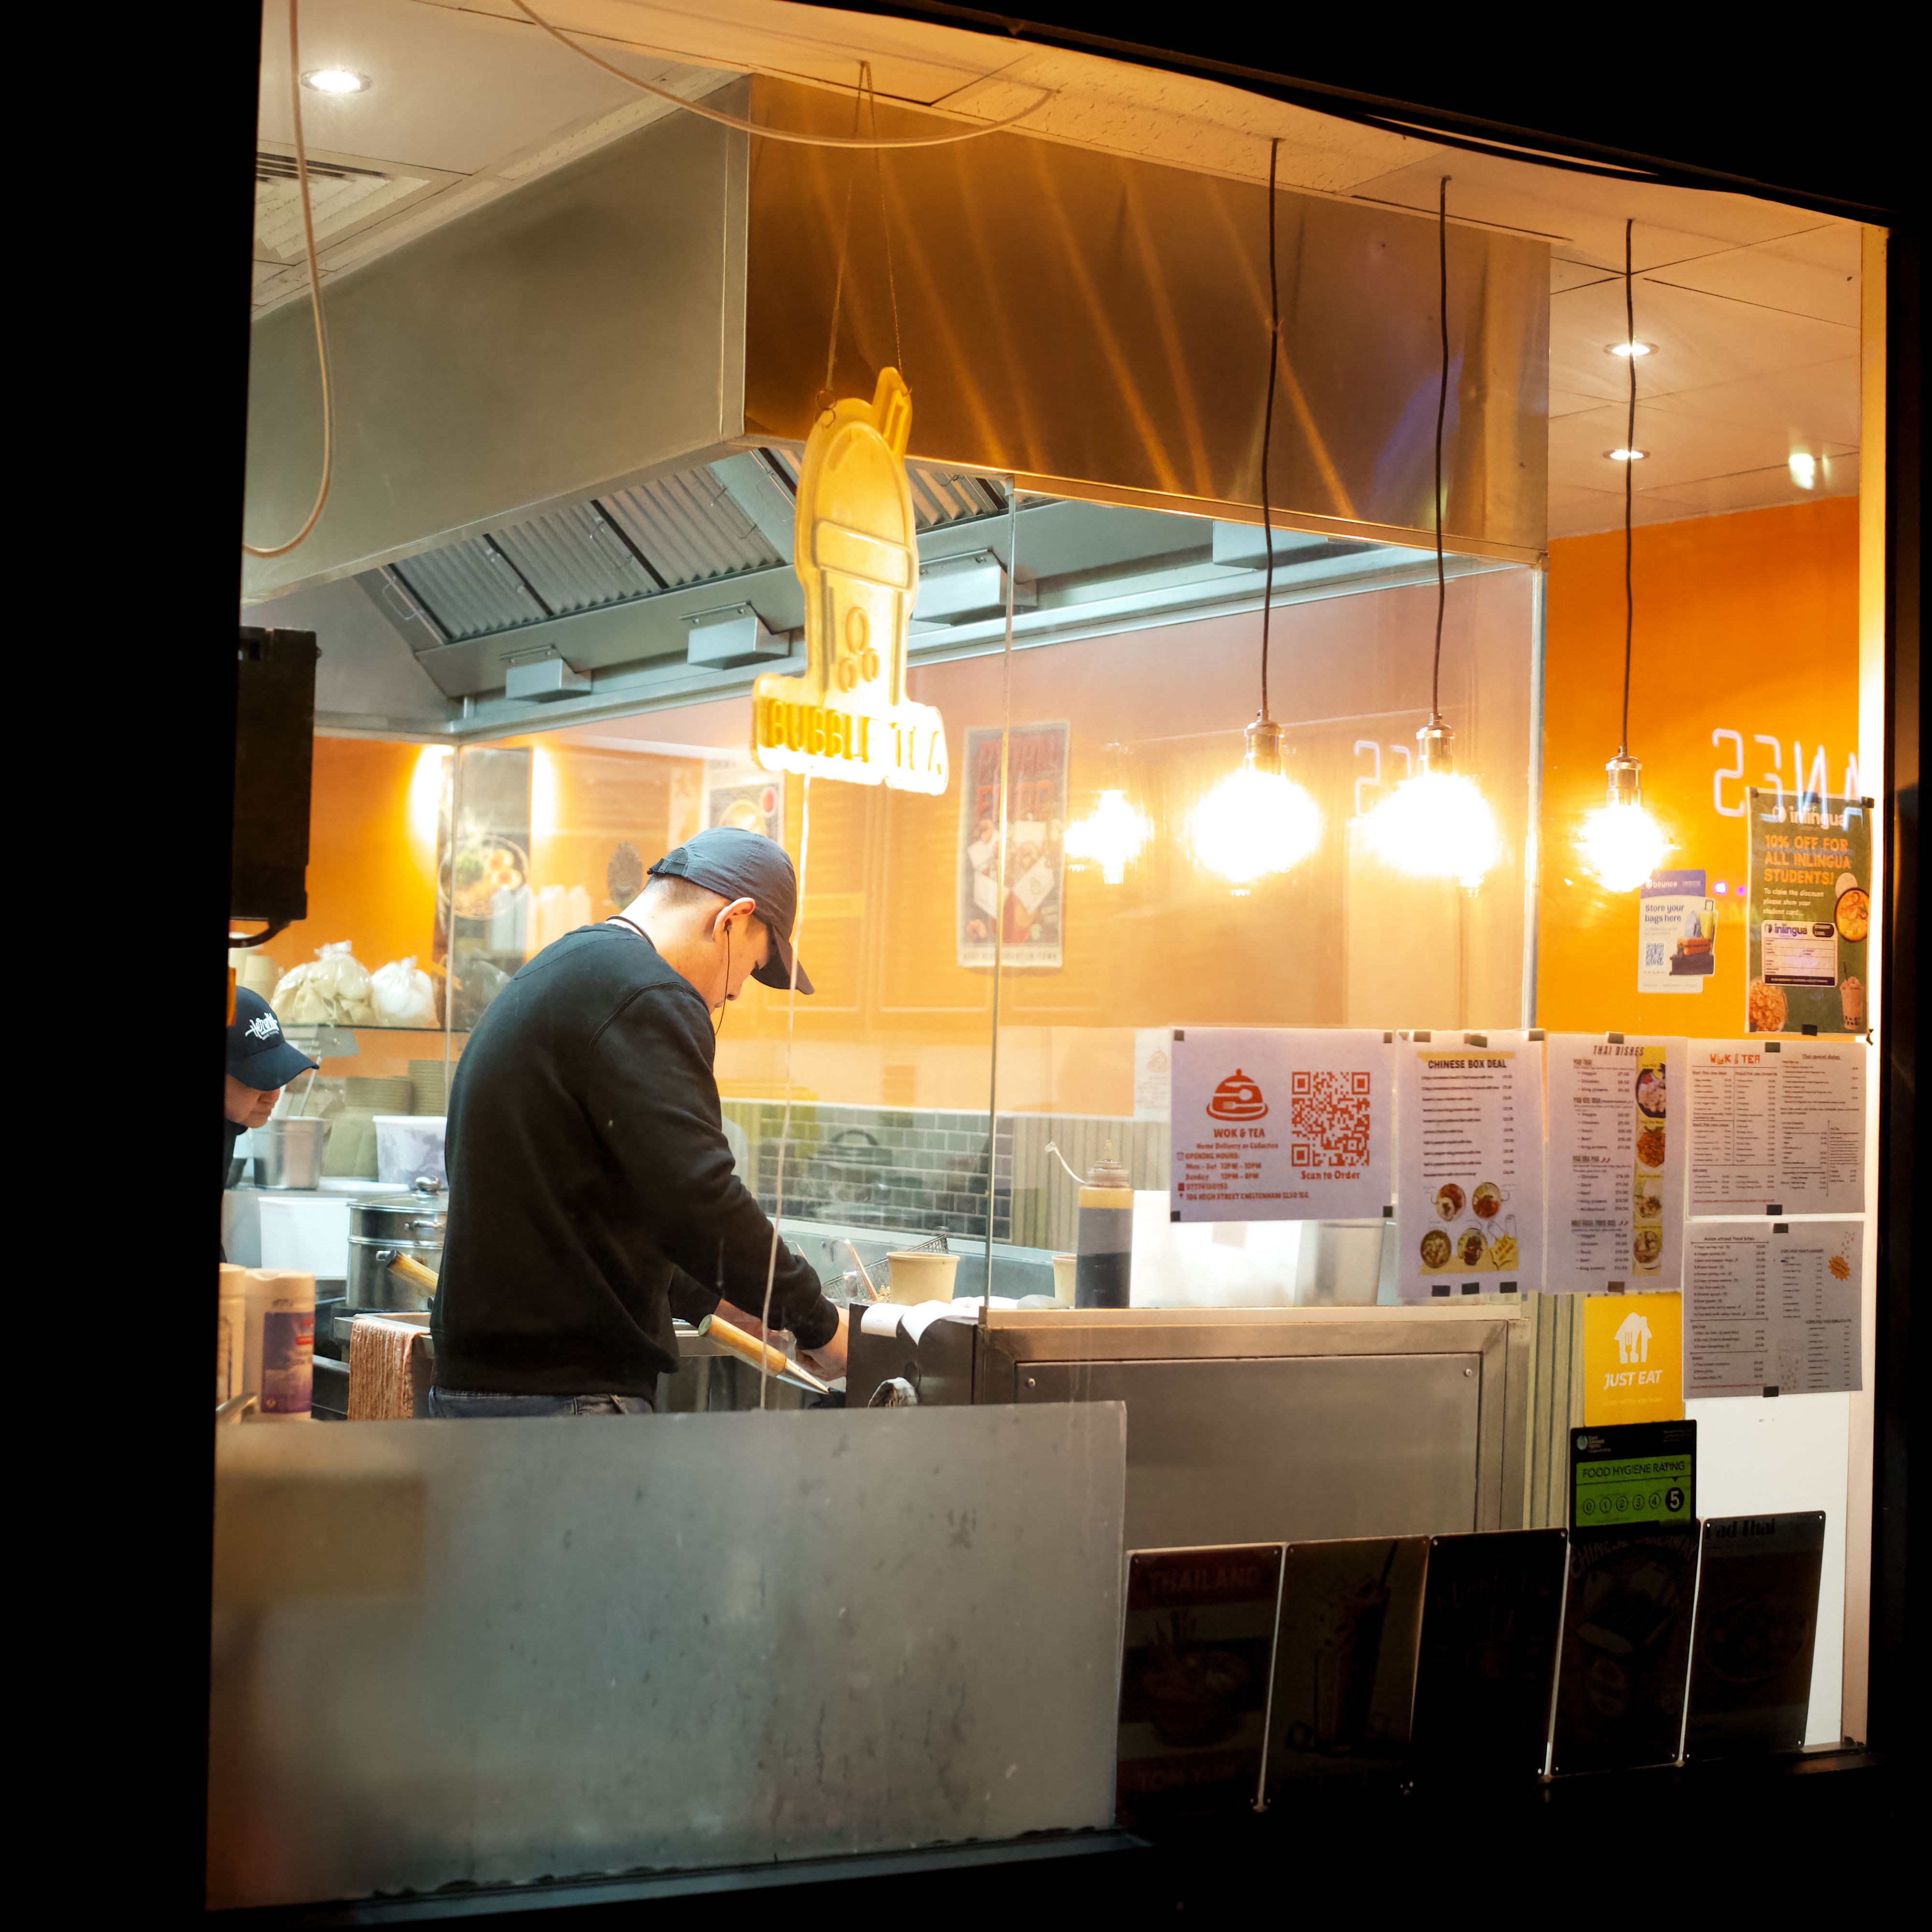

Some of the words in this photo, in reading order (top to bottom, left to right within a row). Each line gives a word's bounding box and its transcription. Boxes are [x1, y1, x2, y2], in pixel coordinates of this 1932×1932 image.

[763, 697, 877, 764] BUBBLE
[1765, 835, 1789, 848] 10%
[1794, 836, 1818, 850] OFF
[1823, 837, 1848, 852] FOR
[1765, 851, 1789, 865] ALL
[1794, 853, 1851, 869] INLINGUA
[1764, 868, 1835, 885] STUDENTS!
[1653, 880, 1677, 888] bounce
[1666, 905, 1685, 914] your
[1645, 914, 1663, 924] bags
[1774, 923, 1808, 937] inlingua
[1593, 1045, 1612, 1055] THAI
[1615, 1046, 1644, 1057] DISHES
[1428, 1060, 1465, 1068] CHINESE
[1468, 1060, 1485, 1068] BOX
[1487, 1059, 1507, 1068] DEAL
[1742, 1054, 1760, 1064] TEA
[1214, 1128, 1238, 1138] WOK
[1240, 1128, 1246, 1138] &
[1248, 1128, 1265, 1138] TEA
[1301, 1170, 1322, 1180] Scan
[1323, 1171, 1332, 1180] to
[1334, 1170, 1360, 1180] Order
[1603, 1371, 1636, 1390] JUST
[1638, 1369, 1663, 1384] EAT
[1583, 1467, 1611, 1478] FOOD
[1613, 1463, 1651, 1476] HYGIENE
[1653, 1461, 1685, 1472] RATING
[1669, 1490, 1680, 1510] 5
[1148, 1565, 1261, 1594] THAILAND
